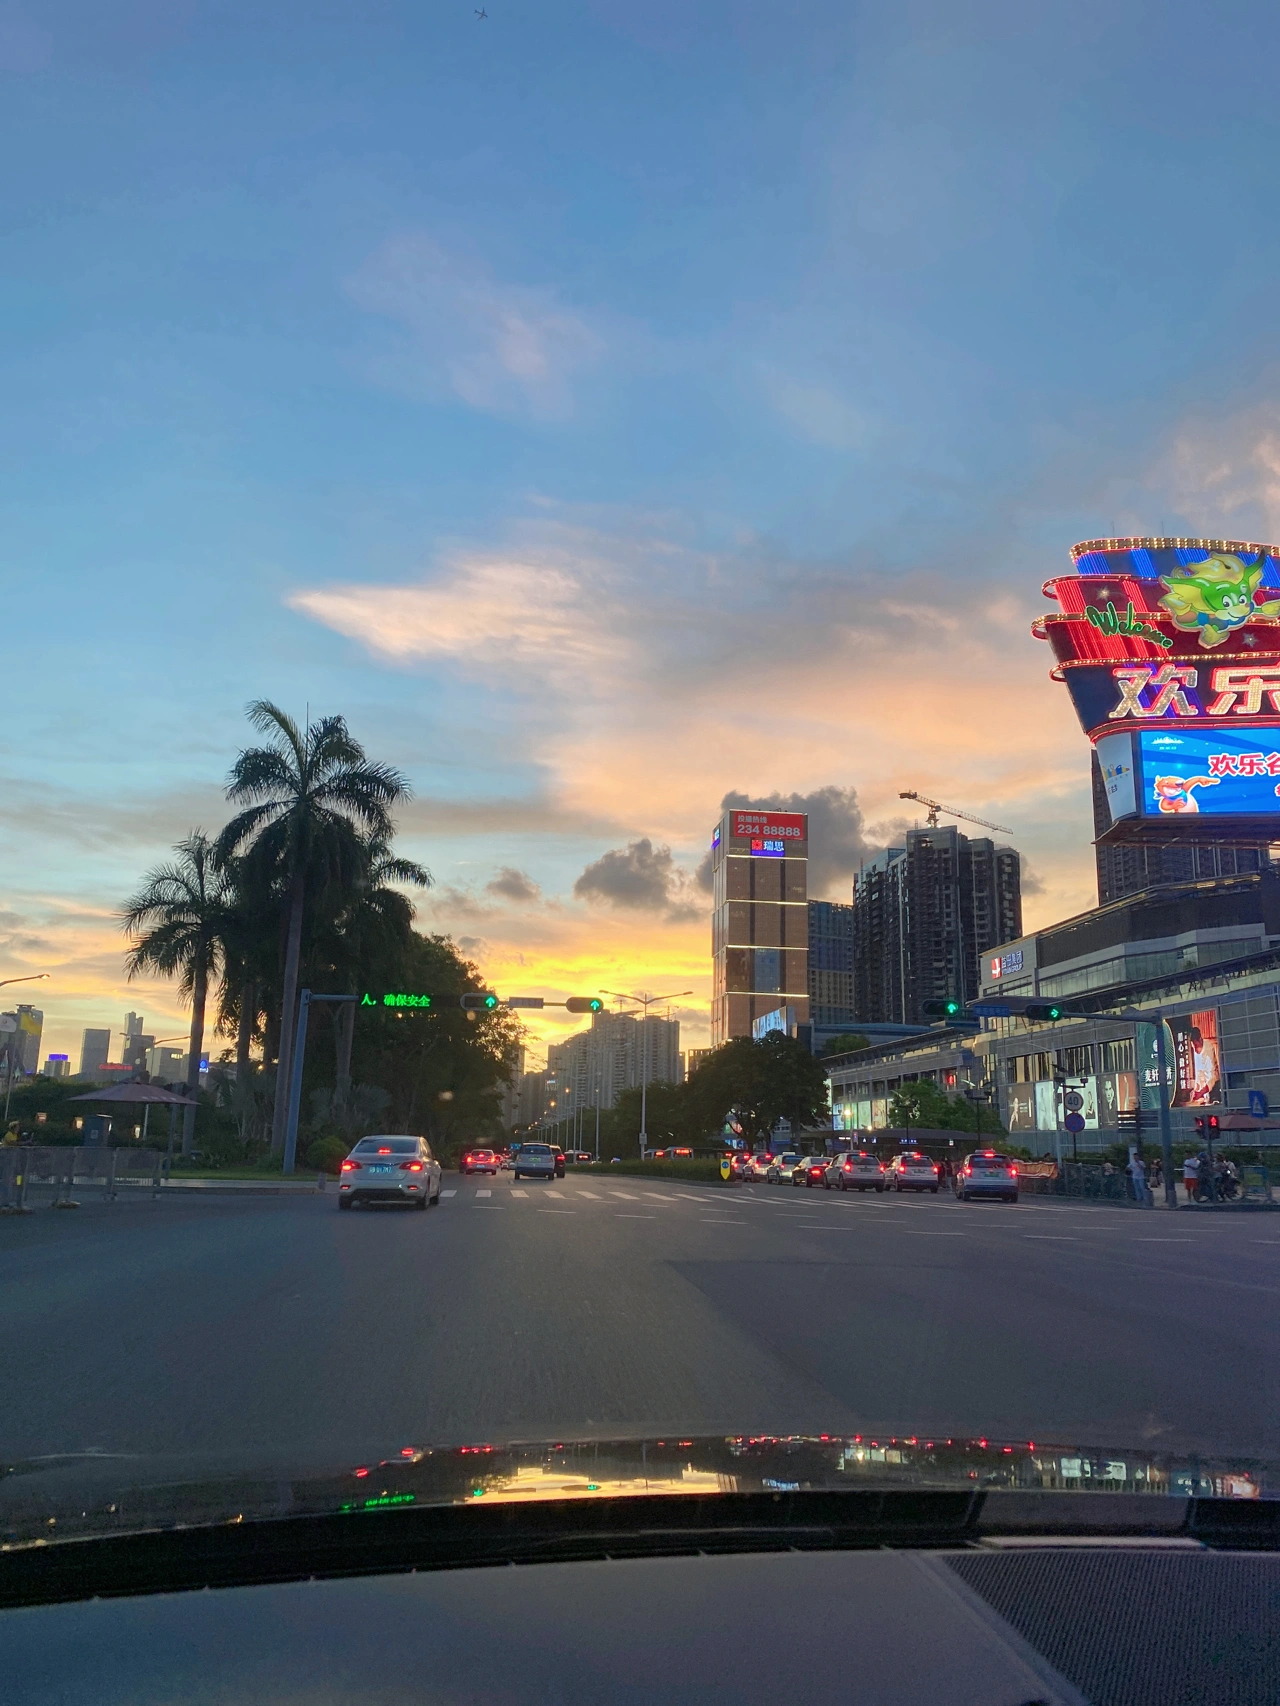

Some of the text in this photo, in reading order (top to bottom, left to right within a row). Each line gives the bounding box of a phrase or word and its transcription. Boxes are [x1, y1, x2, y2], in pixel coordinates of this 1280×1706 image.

[1086, 601, 1173, 649] Welcome
[737, 824, 801, 837] 234 88888
[1068, 1096, 1079, 1106] 40
